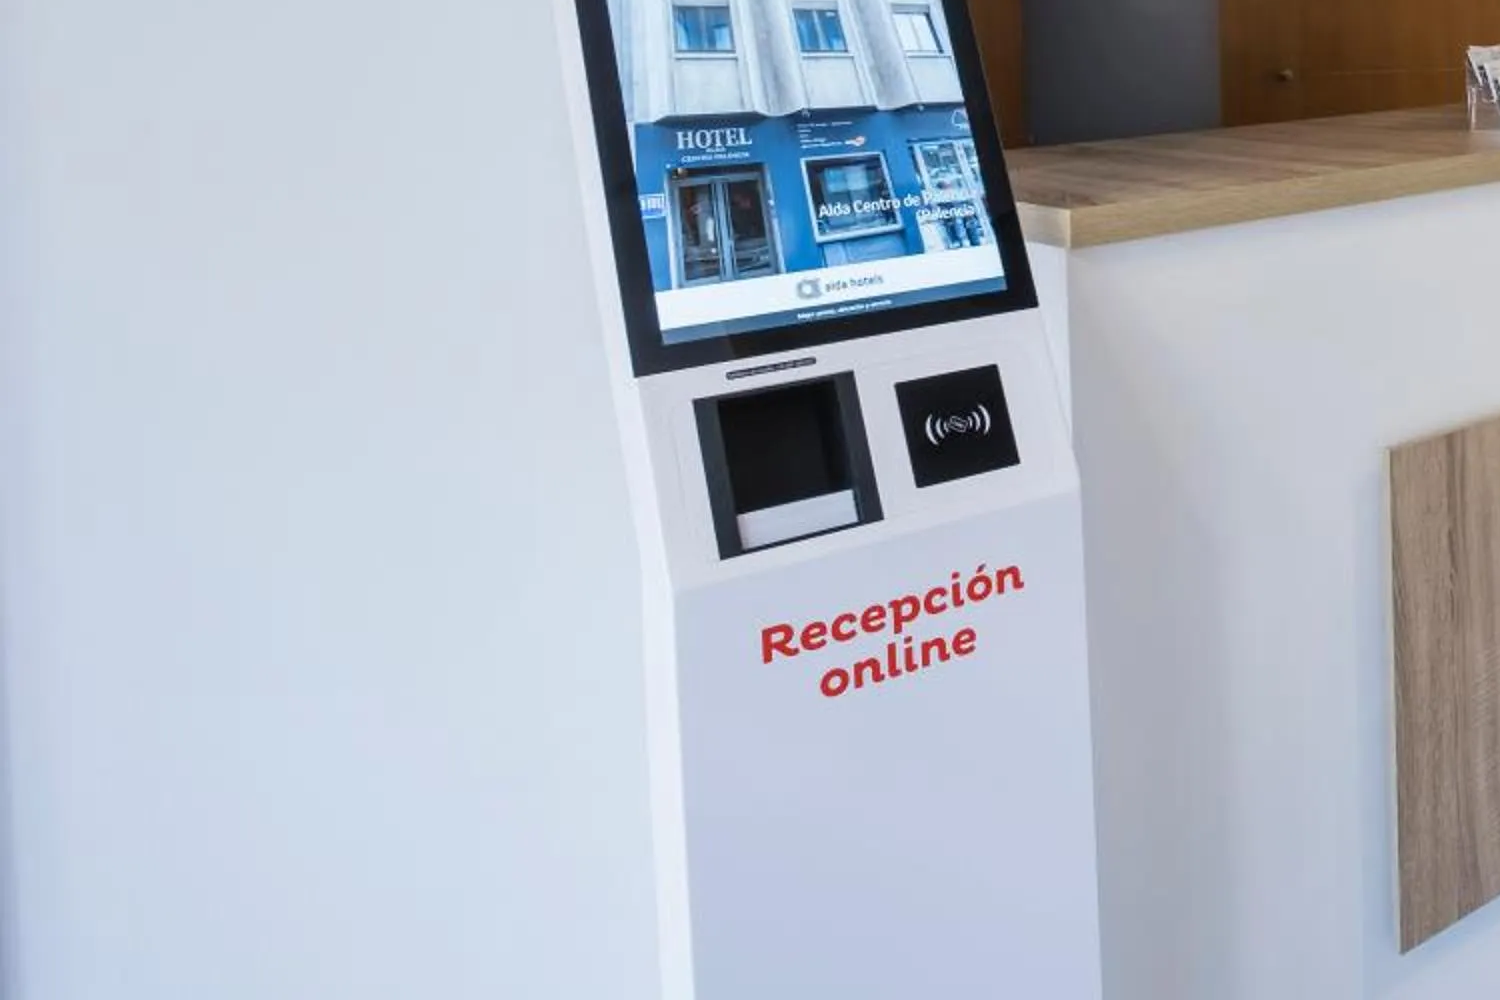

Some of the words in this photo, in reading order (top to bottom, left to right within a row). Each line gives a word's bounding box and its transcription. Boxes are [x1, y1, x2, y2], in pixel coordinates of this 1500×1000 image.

[676, 127, 753, 149] HOTEL
[818, 202, 851, 218] Alda
[853, 198, 901, 214] Centro
[903, 193, 921, 208] de
[760, 562, 1025, 664] Recepción
[819, 627, 977, 697] online
